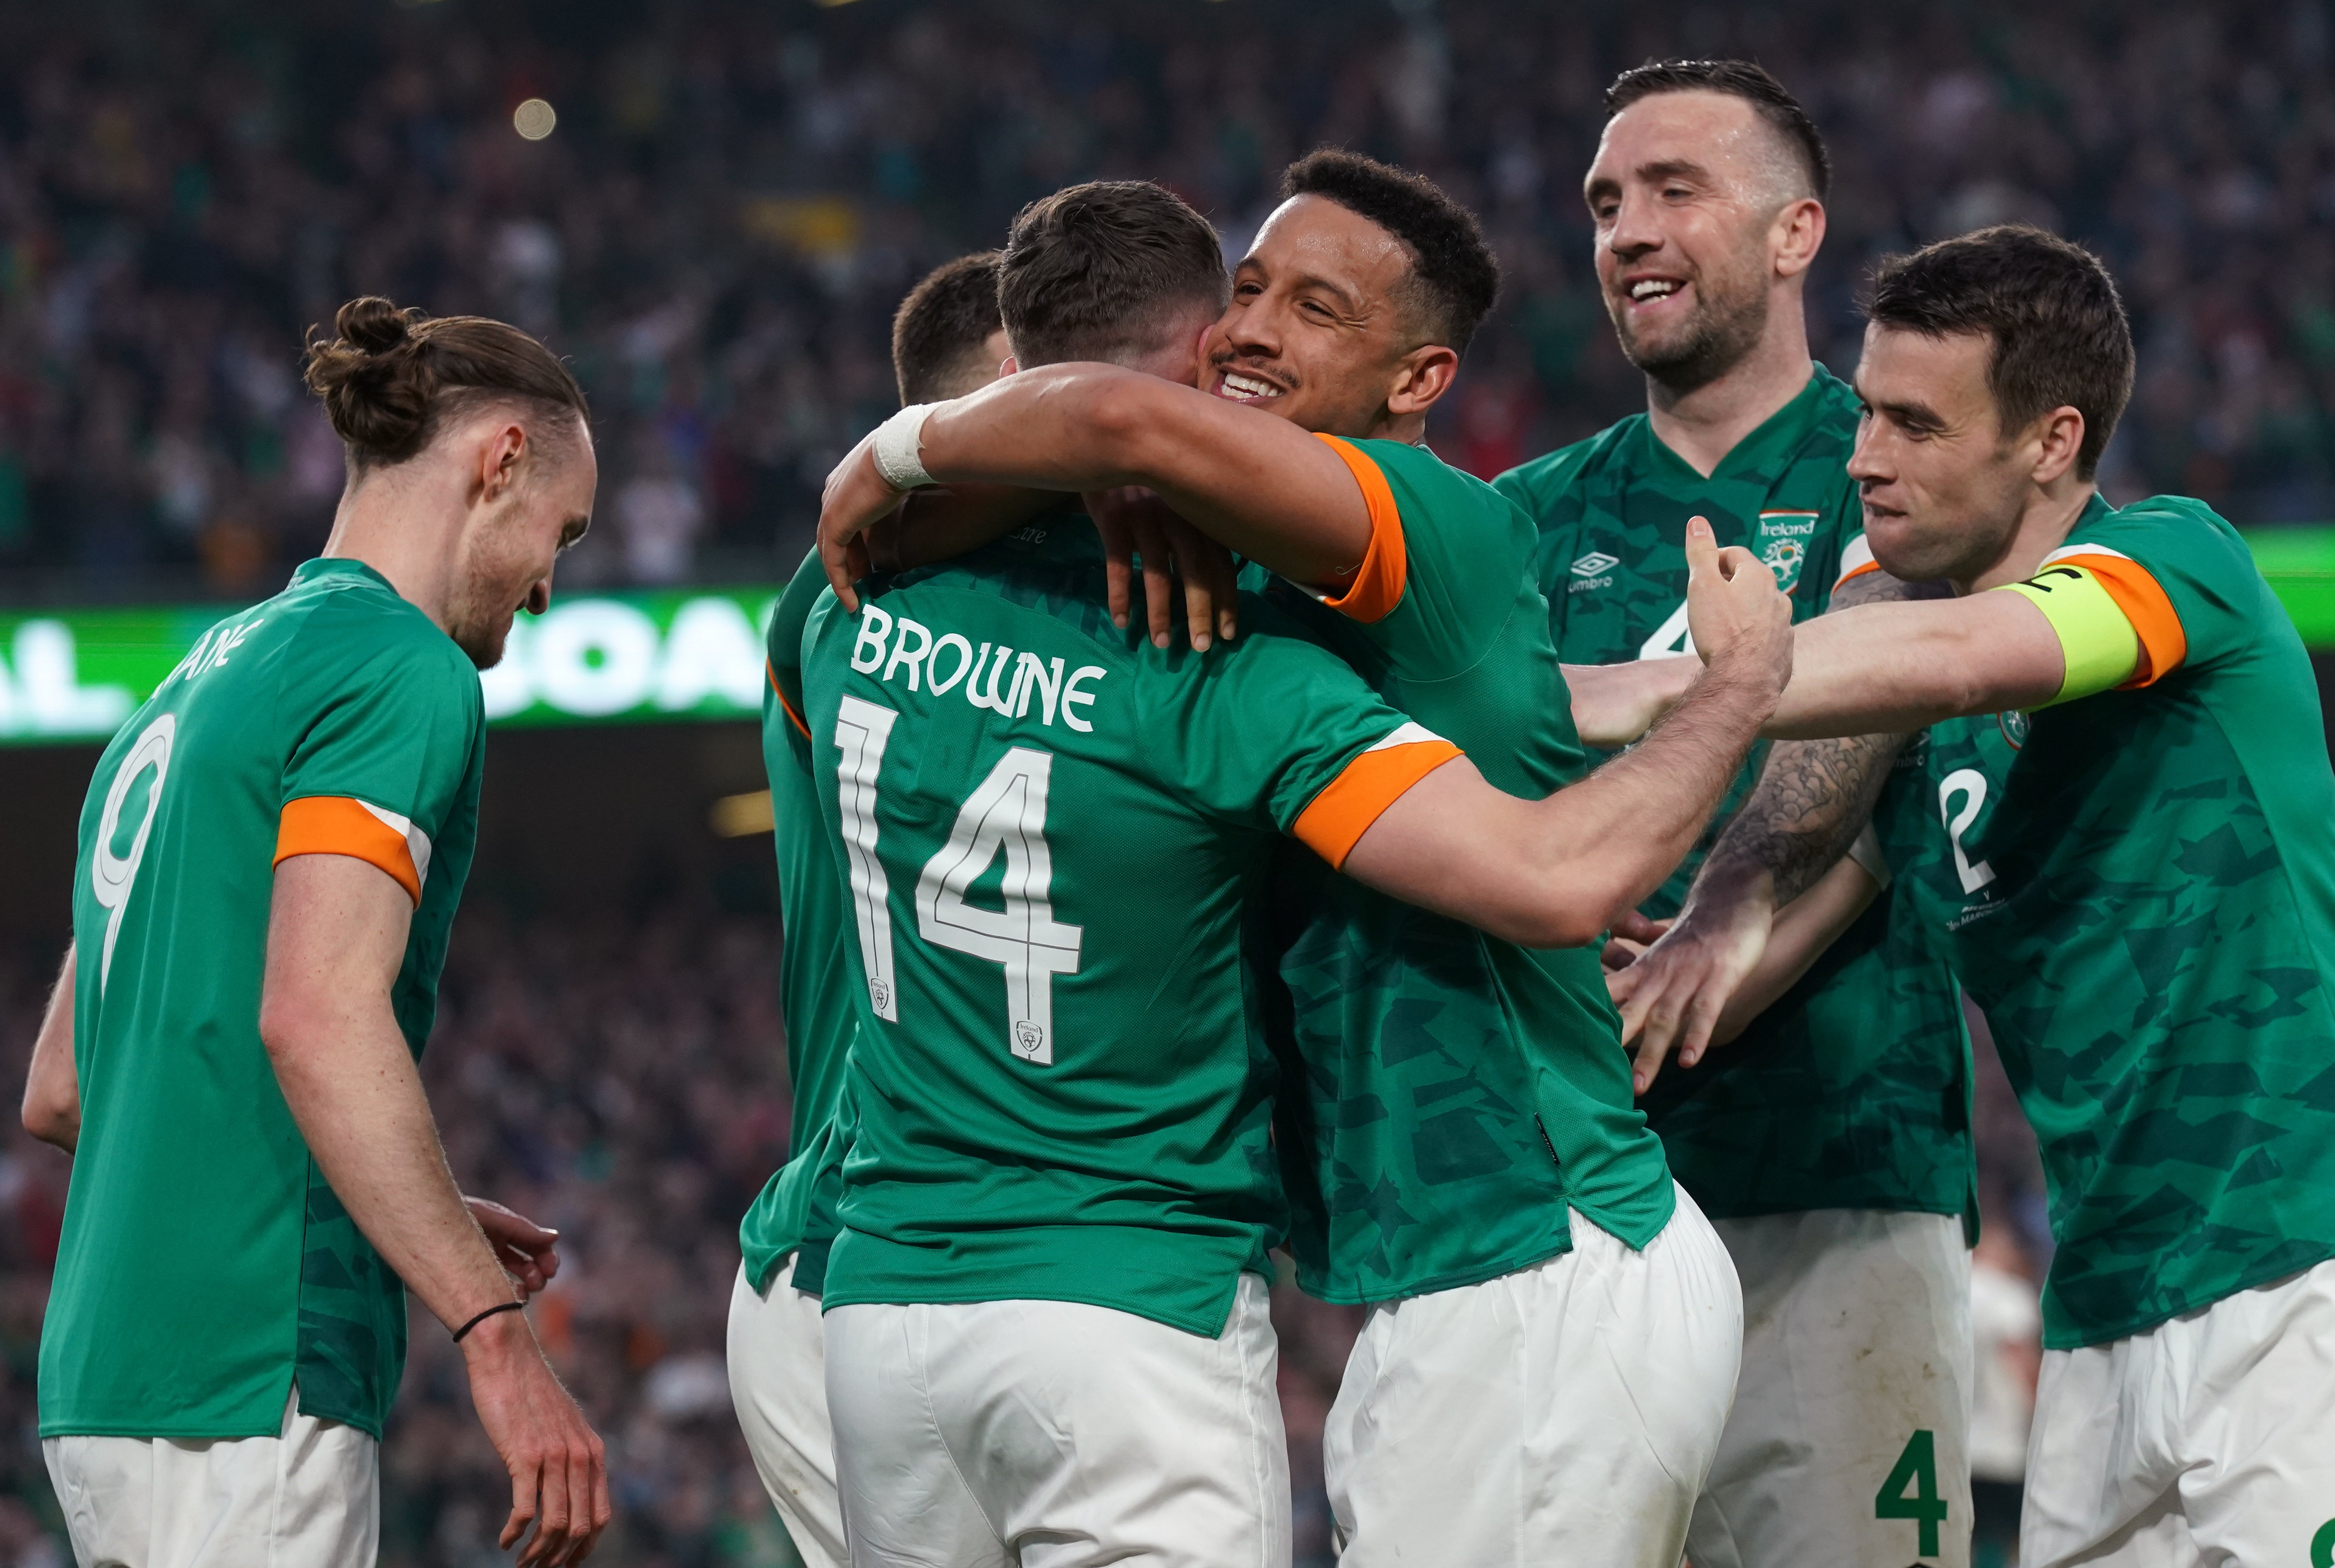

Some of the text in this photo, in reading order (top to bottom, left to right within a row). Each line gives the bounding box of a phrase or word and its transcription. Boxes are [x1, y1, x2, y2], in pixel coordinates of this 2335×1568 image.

[1006, 526, 1047, 544] ire
[1568, 576, 1613, 593] umbro
[1761, 519, 1815, 537] Ireland
[0, 618, 137, 737] L
[851, 604, 1107, 732] BROWNE
[92, 713, 175, 1003] 9
[834, 693, 1083, 1065] 14
[1938, 768, 1996, 895] 2
[1020, 1023, 1038, 1033] Ireland
[1875, 1429, 1948, 1557] 4
